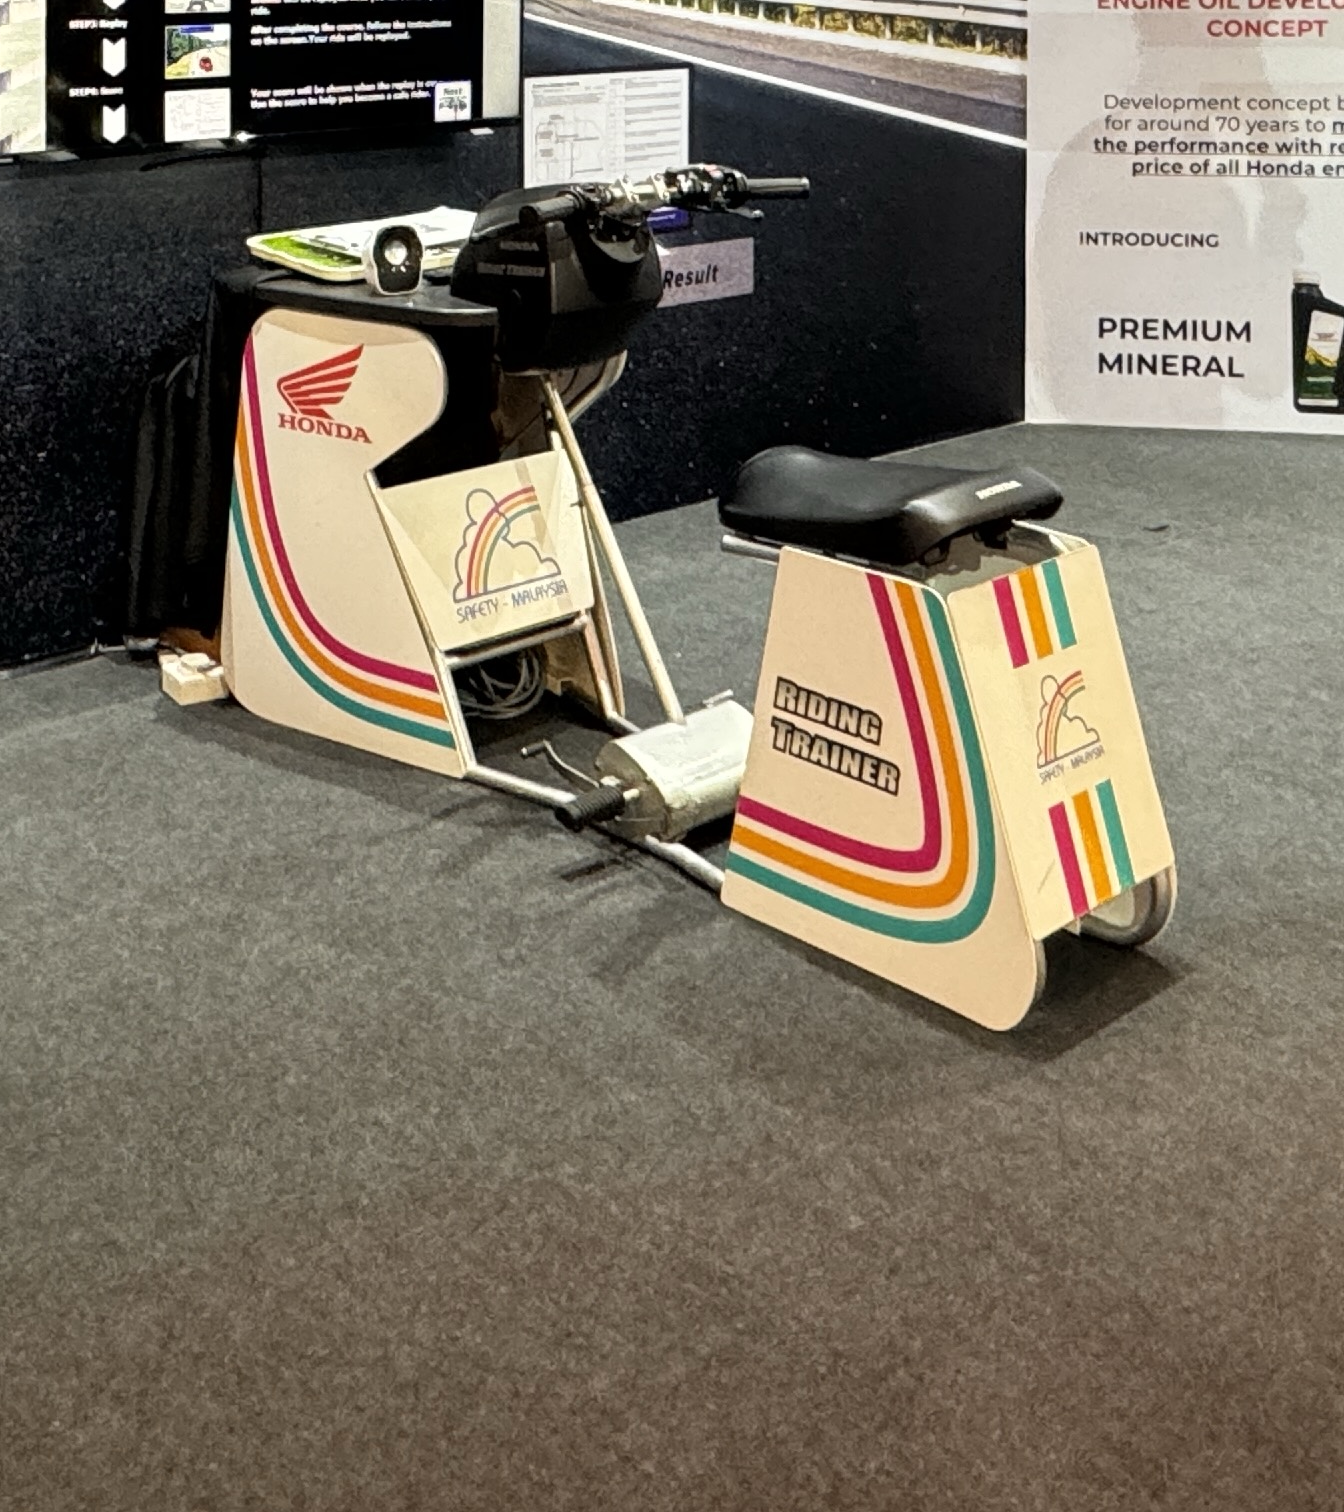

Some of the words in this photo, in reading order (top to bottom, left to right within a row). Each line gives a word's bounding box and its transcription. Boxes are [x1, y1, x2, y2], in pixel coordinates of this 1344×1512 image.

[1206, 18, 1329, 38] CONCEPT
[1104, 93, 1241, 113] Development
[1246, 95, 1330, 114] concept
[1105, 115, 1132, 132] for
[1137, 115, 1209, 132] around
[1215, 115, 1240, 132] 70
[1246, 119, 1300, 136] years
[1305, 118, 1326, 133] to
[1094, 138, 1127, 154] the
[1134, 137, 1269, 157] performance
[1275, 137, 1322, 155] with
[1132, 158, 1183, 178] price
[1189, 159, 1210, 175] of
[1215, 159, 1239, 176] all
[1246, 159, 1316, 177] Honda
[1079, 230, 1220, 249] INTRODUCING
[663, 263, 720, 289] Result
[1097, 317, 1253, 343] PREMIUM
[1097, 352, 1246, 378] MINERAL
[277, 412, 373, 444] HONDA
[456, 597, 499, 624] SAFETY
[511, 578, 569, 608] MALAYSIA
[774, 676, 884, 746] RIDING
[770, 716, 902, 797] TRAINER
